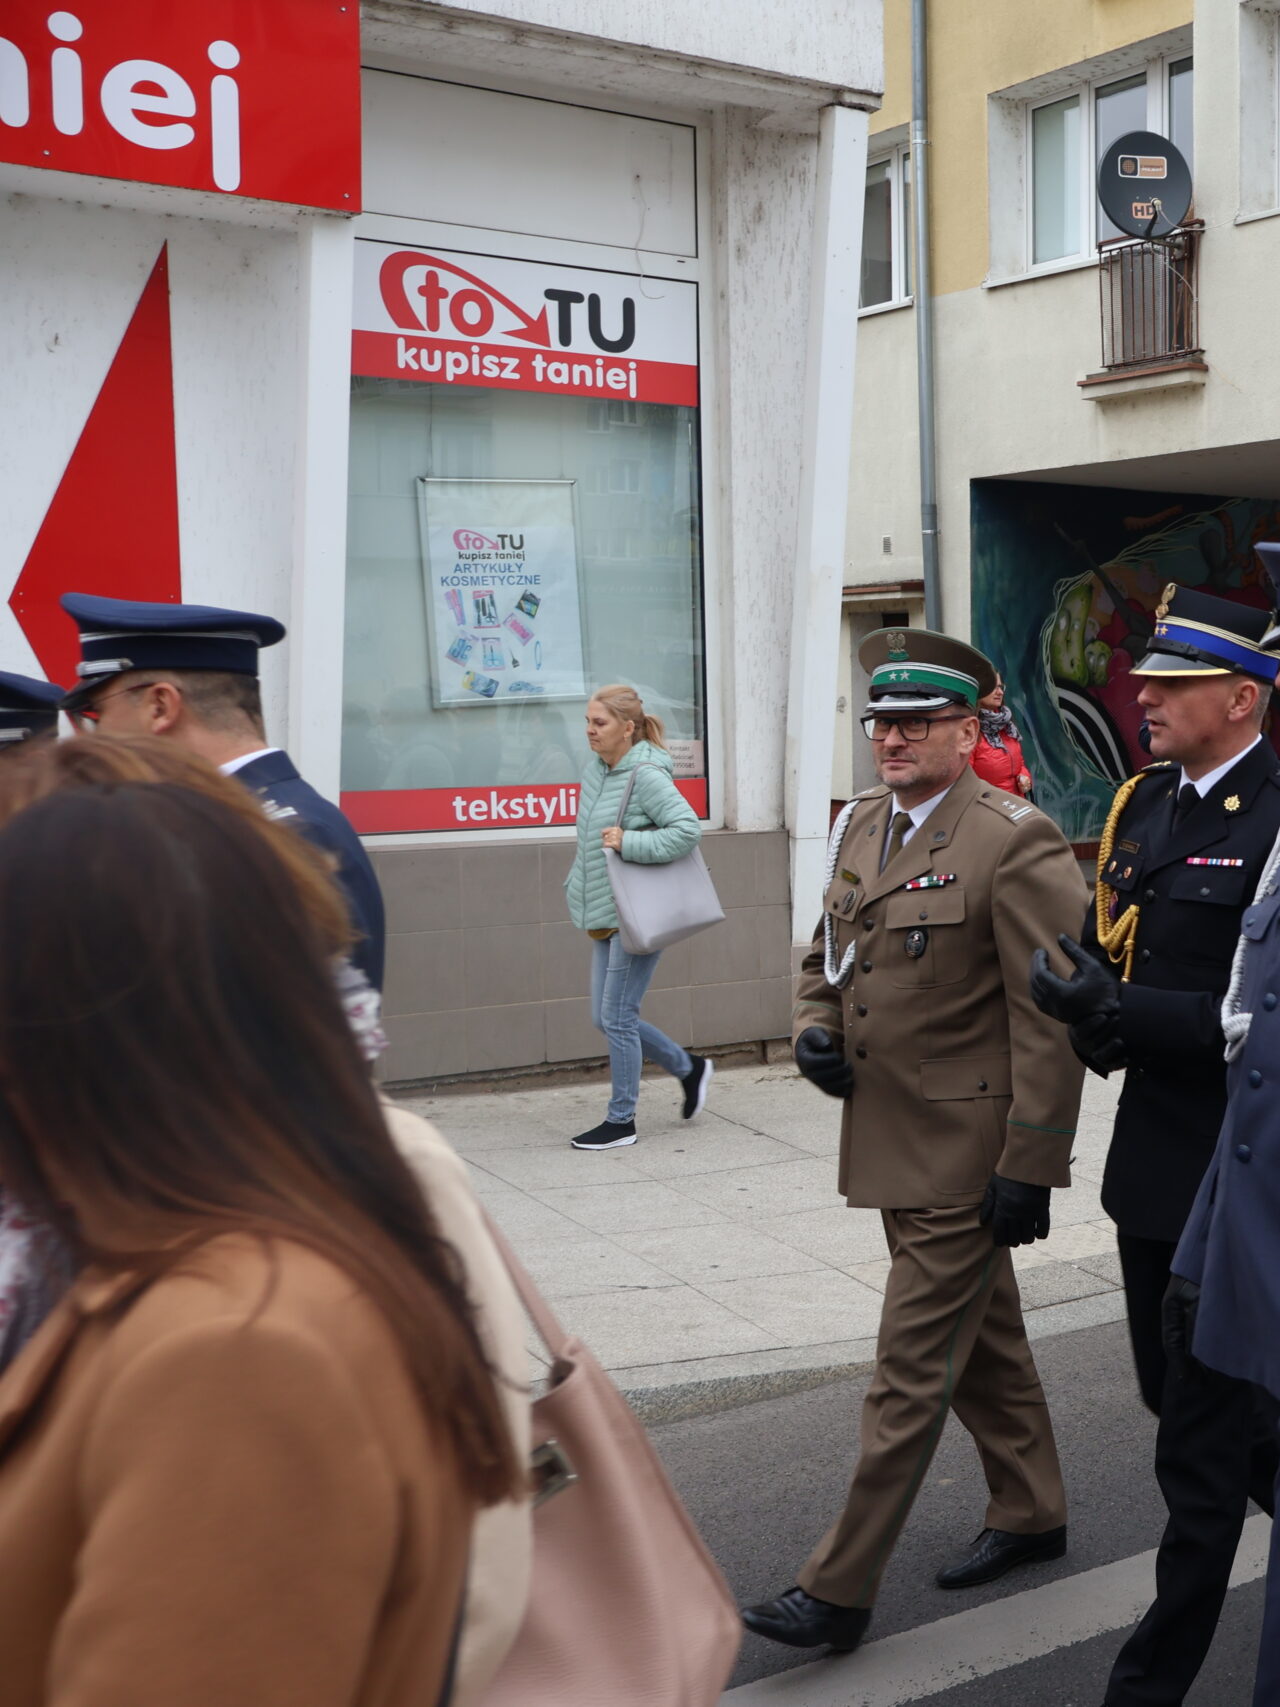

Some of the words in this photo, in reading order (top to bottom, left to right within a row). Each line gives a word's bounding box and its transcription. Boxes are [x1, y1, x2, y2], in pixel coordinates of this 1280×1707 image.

[396, 336, 521, 382] kupisz
[531, 353, 638, 399] taniej
[458, 551, 492, 562] kupisz
[495, 550, 526, 561] taniej
[453, 563, 524, 574] ARTYKUŁY
[440, 575, 541, 588] KOSMETYCZNE
[452, 788, 577, 824] tekstyli
